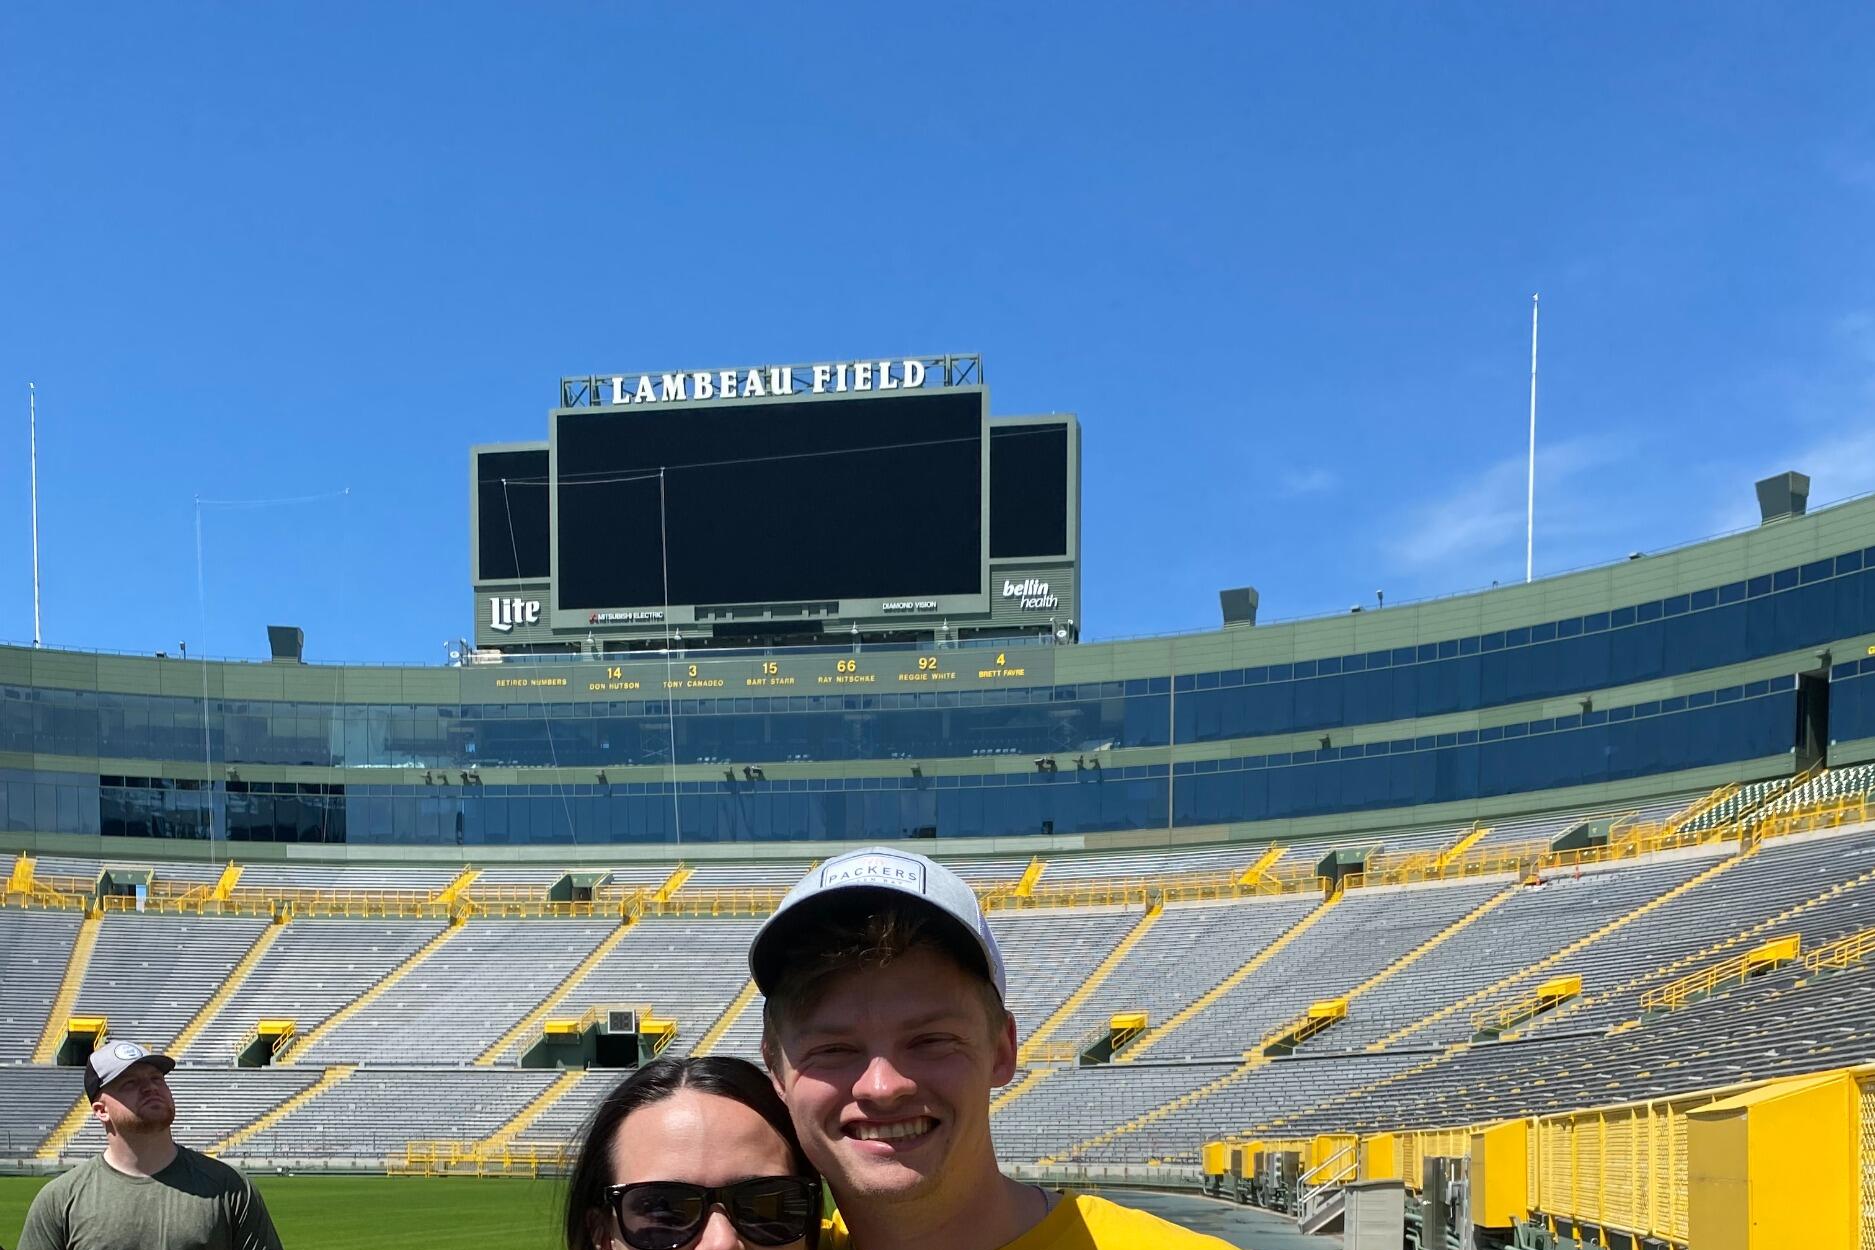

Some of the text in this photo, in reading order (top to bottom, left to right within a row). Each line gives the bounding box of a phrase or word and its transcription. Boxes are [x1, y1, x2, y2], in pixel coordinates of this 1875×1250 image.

[612, 360, 925, 404] LAMBEAU FIELD
[1003, 579, 1049, 596] bellin
[1020, 594, 1058, 608] health
[489, 597, 540, 631] Lite
[633, 611, 664, 619] ELECTRIC
[918, 657, 937, 670] 92
[996, 653, 1006, 666] 4
[688, 665, 698, 677] 3
[762, 662, 778, 674] 15
[836, 659, 857, 673] 66
[607, 667, 622, 680] 14
[898, 672, 957, 681] REGGIE WHITE
[978, 669, 1025, 678] BRETT FAVRE
[496, 678, 567, 687] RETIRED NUMBERS
[608, 682, 640, 690] HUTSON
[686, 680, 724, 688] CANADEO
[746, 677, 795, 686] BART STARR
[817, 676, 833, 684] RAY
[828, 865, 917, 884] PACKERS
